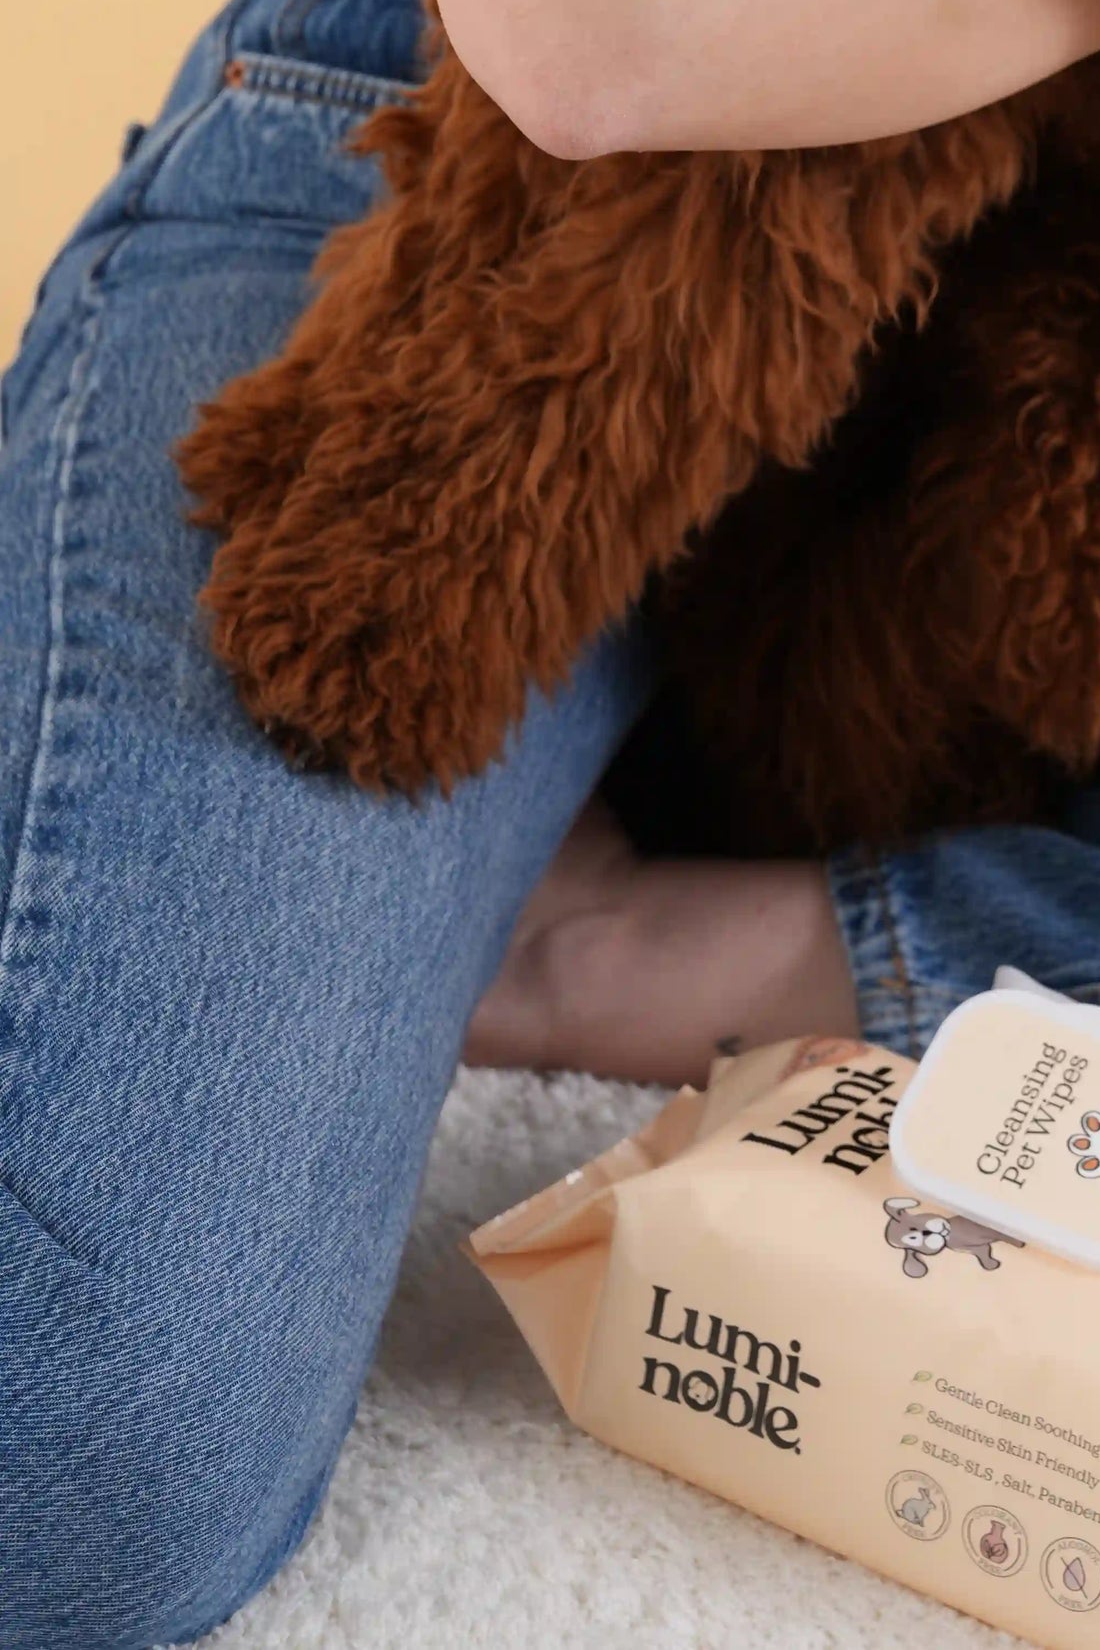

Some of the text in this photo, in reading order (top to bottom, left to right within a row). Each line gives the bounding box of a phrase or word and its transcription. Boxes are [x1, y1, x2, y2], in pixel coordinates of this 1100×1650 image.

[739, 1066, 896, 1156] Lumi-
[976, 1042, 1067, 1175] Cleansing
[1000, 1055, 1088, 1189] Pet Wipes
[645, 1284, 821, 1394] Lumi-
[638, 1356, 801, 1455] noble.
[926, 1410, 1100, 1490] Sensitive Skin Friendly
[935, 1378, 1100, 1459] Gentle Clean Soothing
